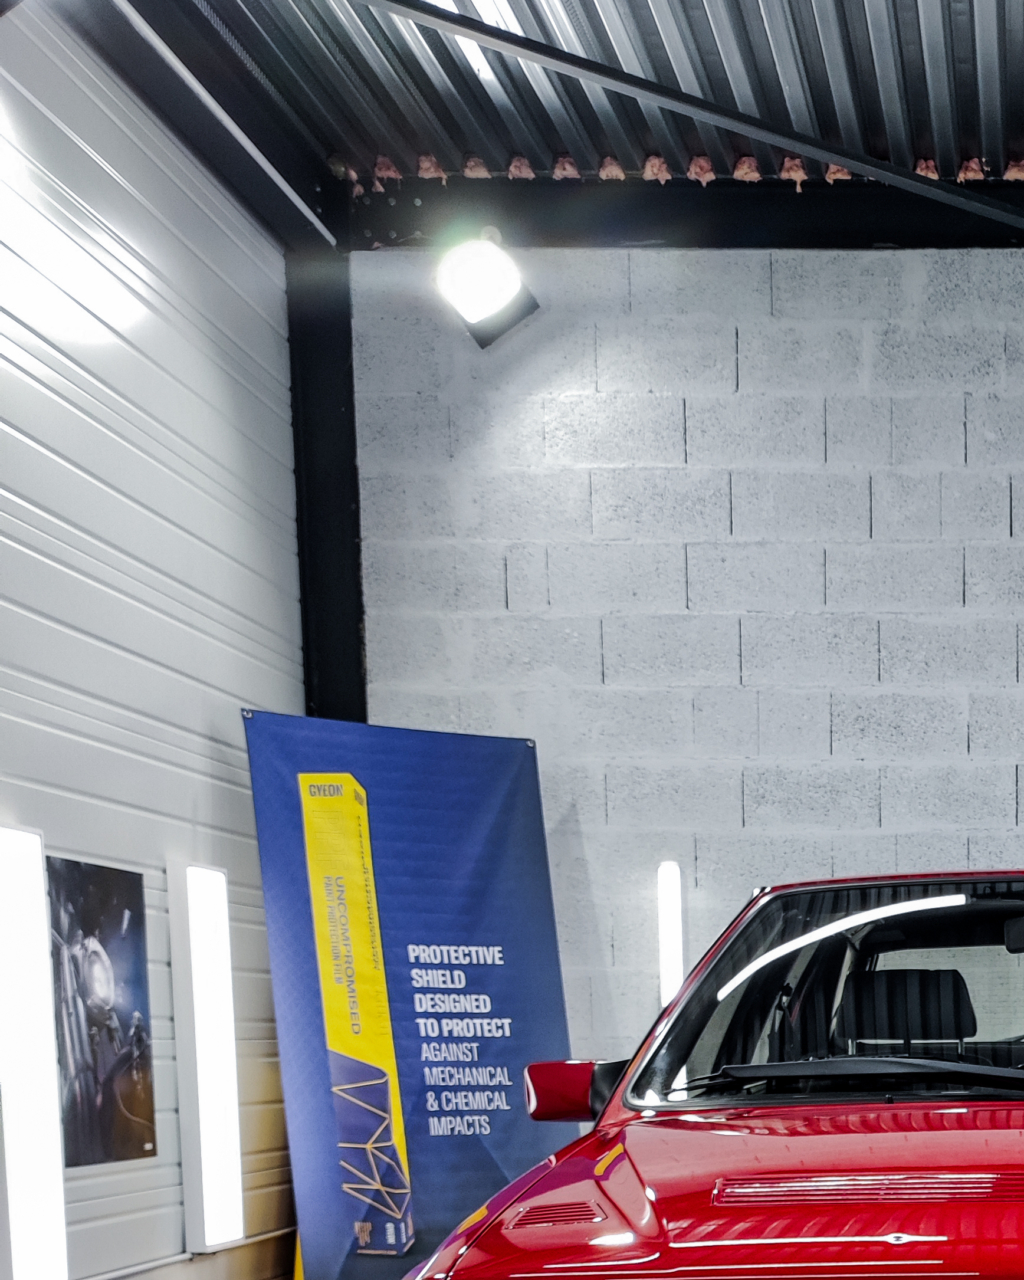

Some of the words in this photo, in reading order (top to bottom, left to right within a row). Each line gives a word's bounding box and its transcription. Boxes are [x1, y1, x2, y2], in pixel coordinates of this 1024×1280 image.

[309, 784, 343, 797] GYEON
[324, 876, 334, 902] PAINT
[327, 905, 341, 961] PROTECTION
[336, 876, 361, 1035] UNCOMPROMISED
[407, 944, 504, 965] PROTECTIVE
[334, 963, 343, 984] FILM
[410, 968, 466, 989] SHIELD
[413, 993, 492, 1013] DESIGNED
[415, 1018, 440, 1037] TO
[441, 1018, 512, 1037] PROTECT
[421, 1042, 479, 1062] AGAINST
[423, 1066, 513, 1086] MECHANICAL
[426, 1091, 439, 1111] &
[441, 1091, 511, 1111] CHEMICAL
[428, 1115, 491, 1136] IMPACTS
